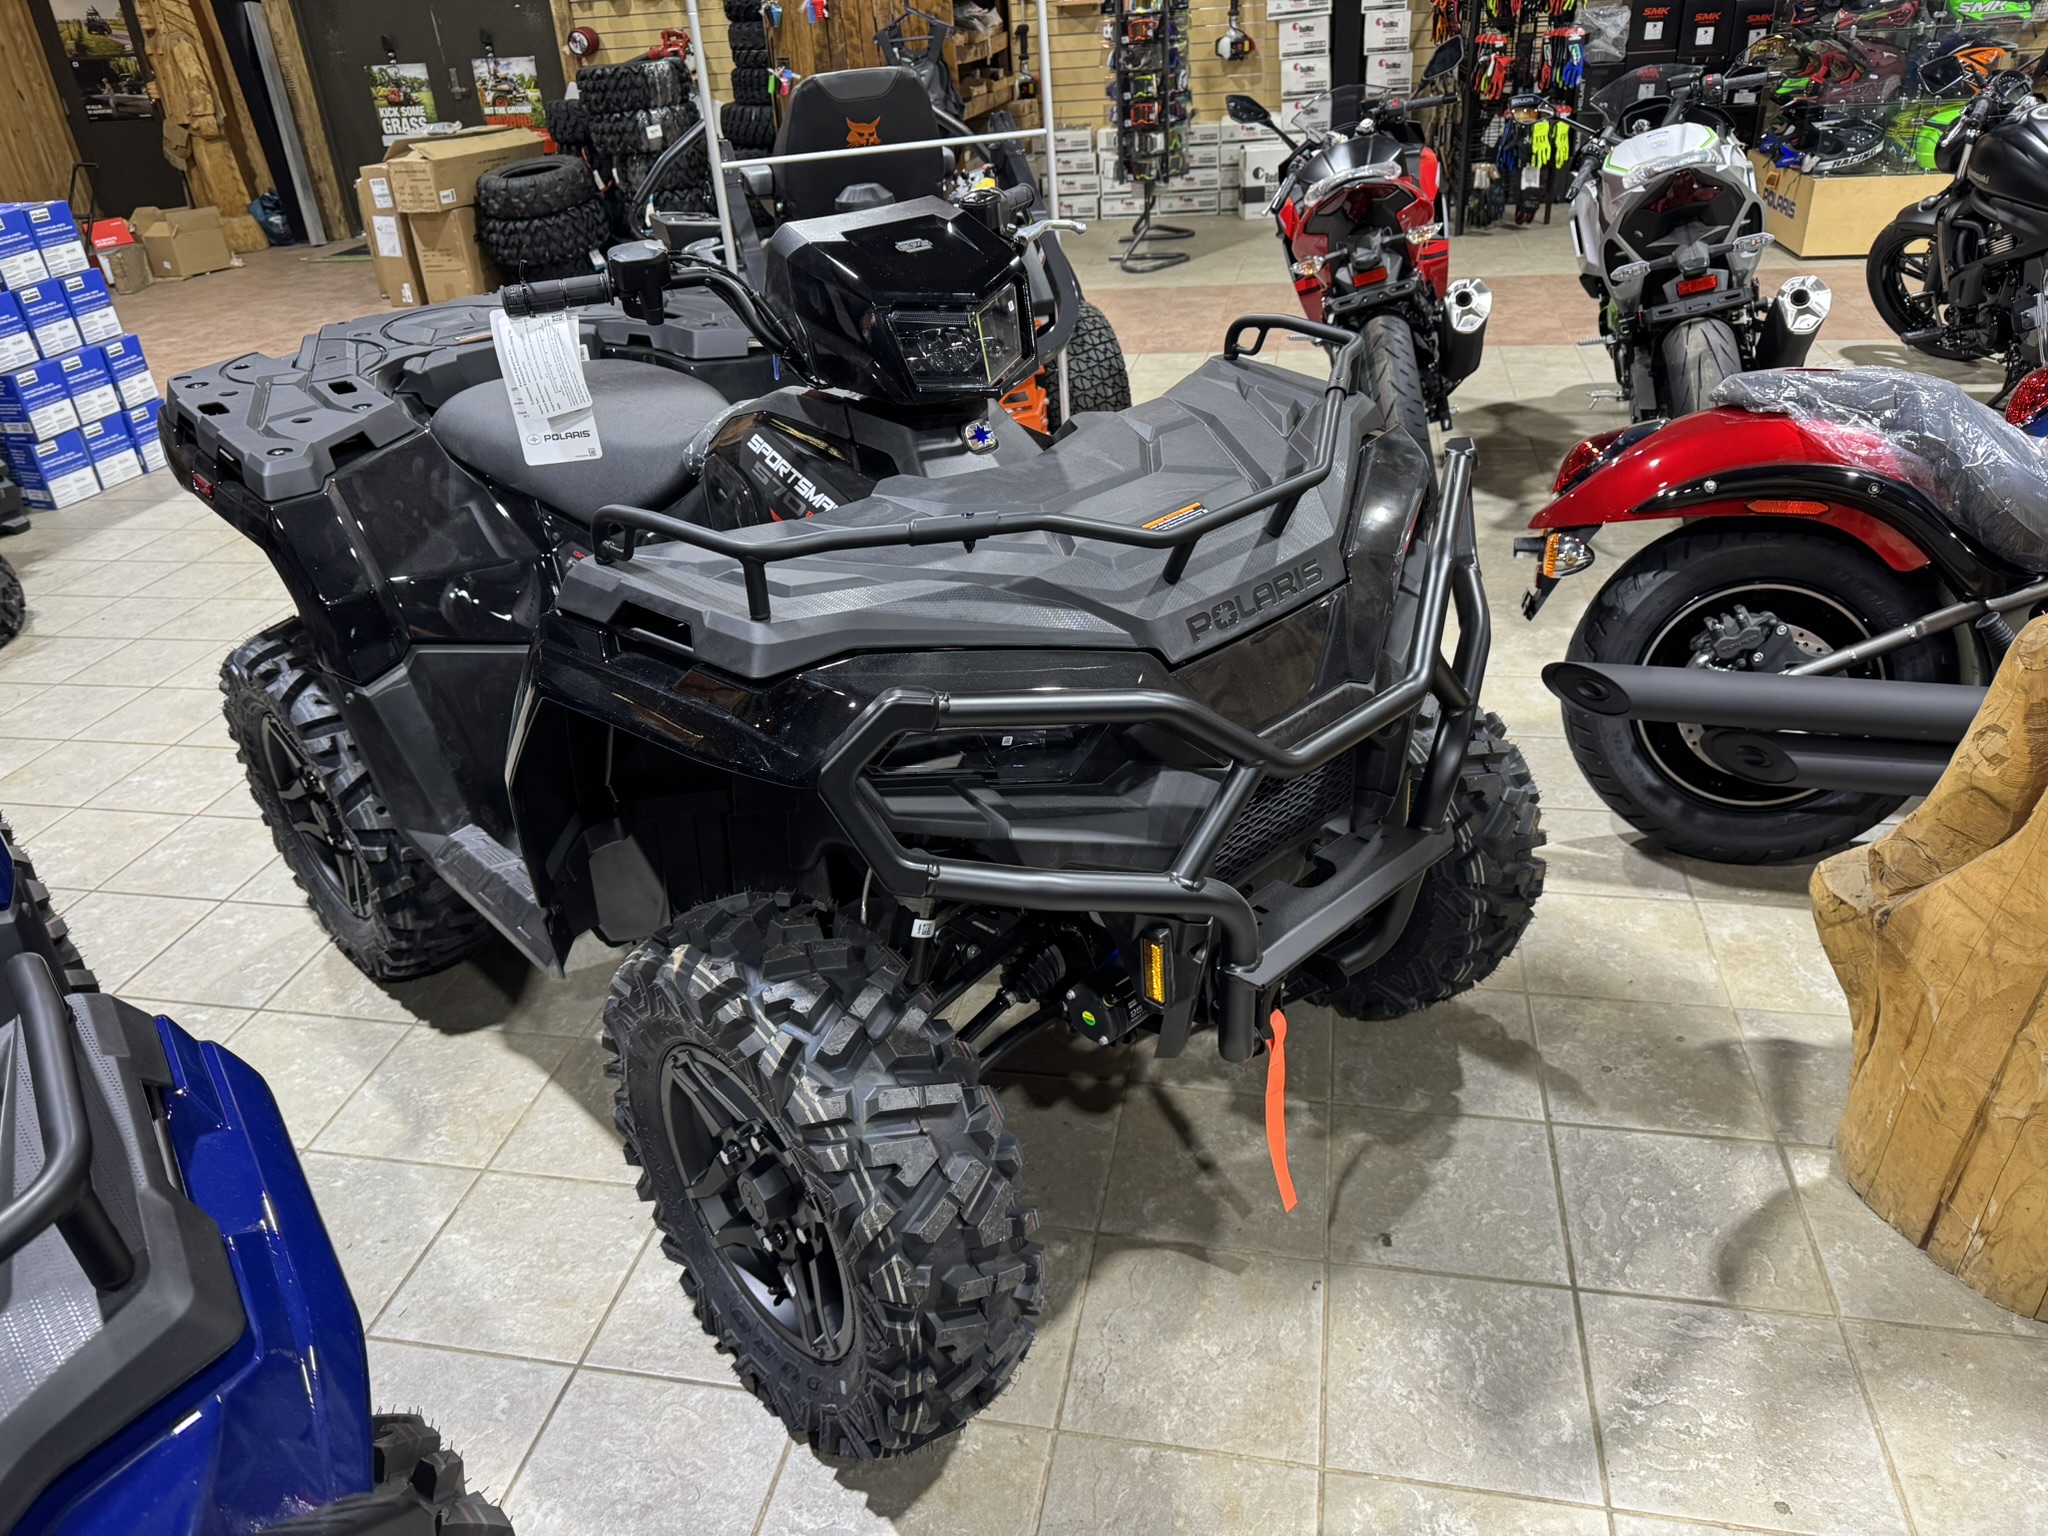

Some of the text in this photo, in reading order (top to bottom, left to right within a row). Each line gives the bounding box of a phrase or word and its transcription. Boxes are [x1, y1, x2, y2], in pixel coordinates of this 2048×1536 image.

[1643, 6, 1671, 16] SMK
[1958, 1, 2007, 13] SMK
[1694, 12, 1722, 22] SMK
[1746, 13, 1773, 23] SMK
[378, 105, 426, 118] KICK SOME
[381, 116, 428, 134] GRASS
[1832, 147, 1877, 168] RACING
[1762, 187, 1797, 219] POLARIS
[544, 430, 591, 442] POLARIS
[746, 433, 838, 512] SPORTSMA
[751, 461, 807, 517] 570
[1185, 558, 1323, 644] POLARIS
